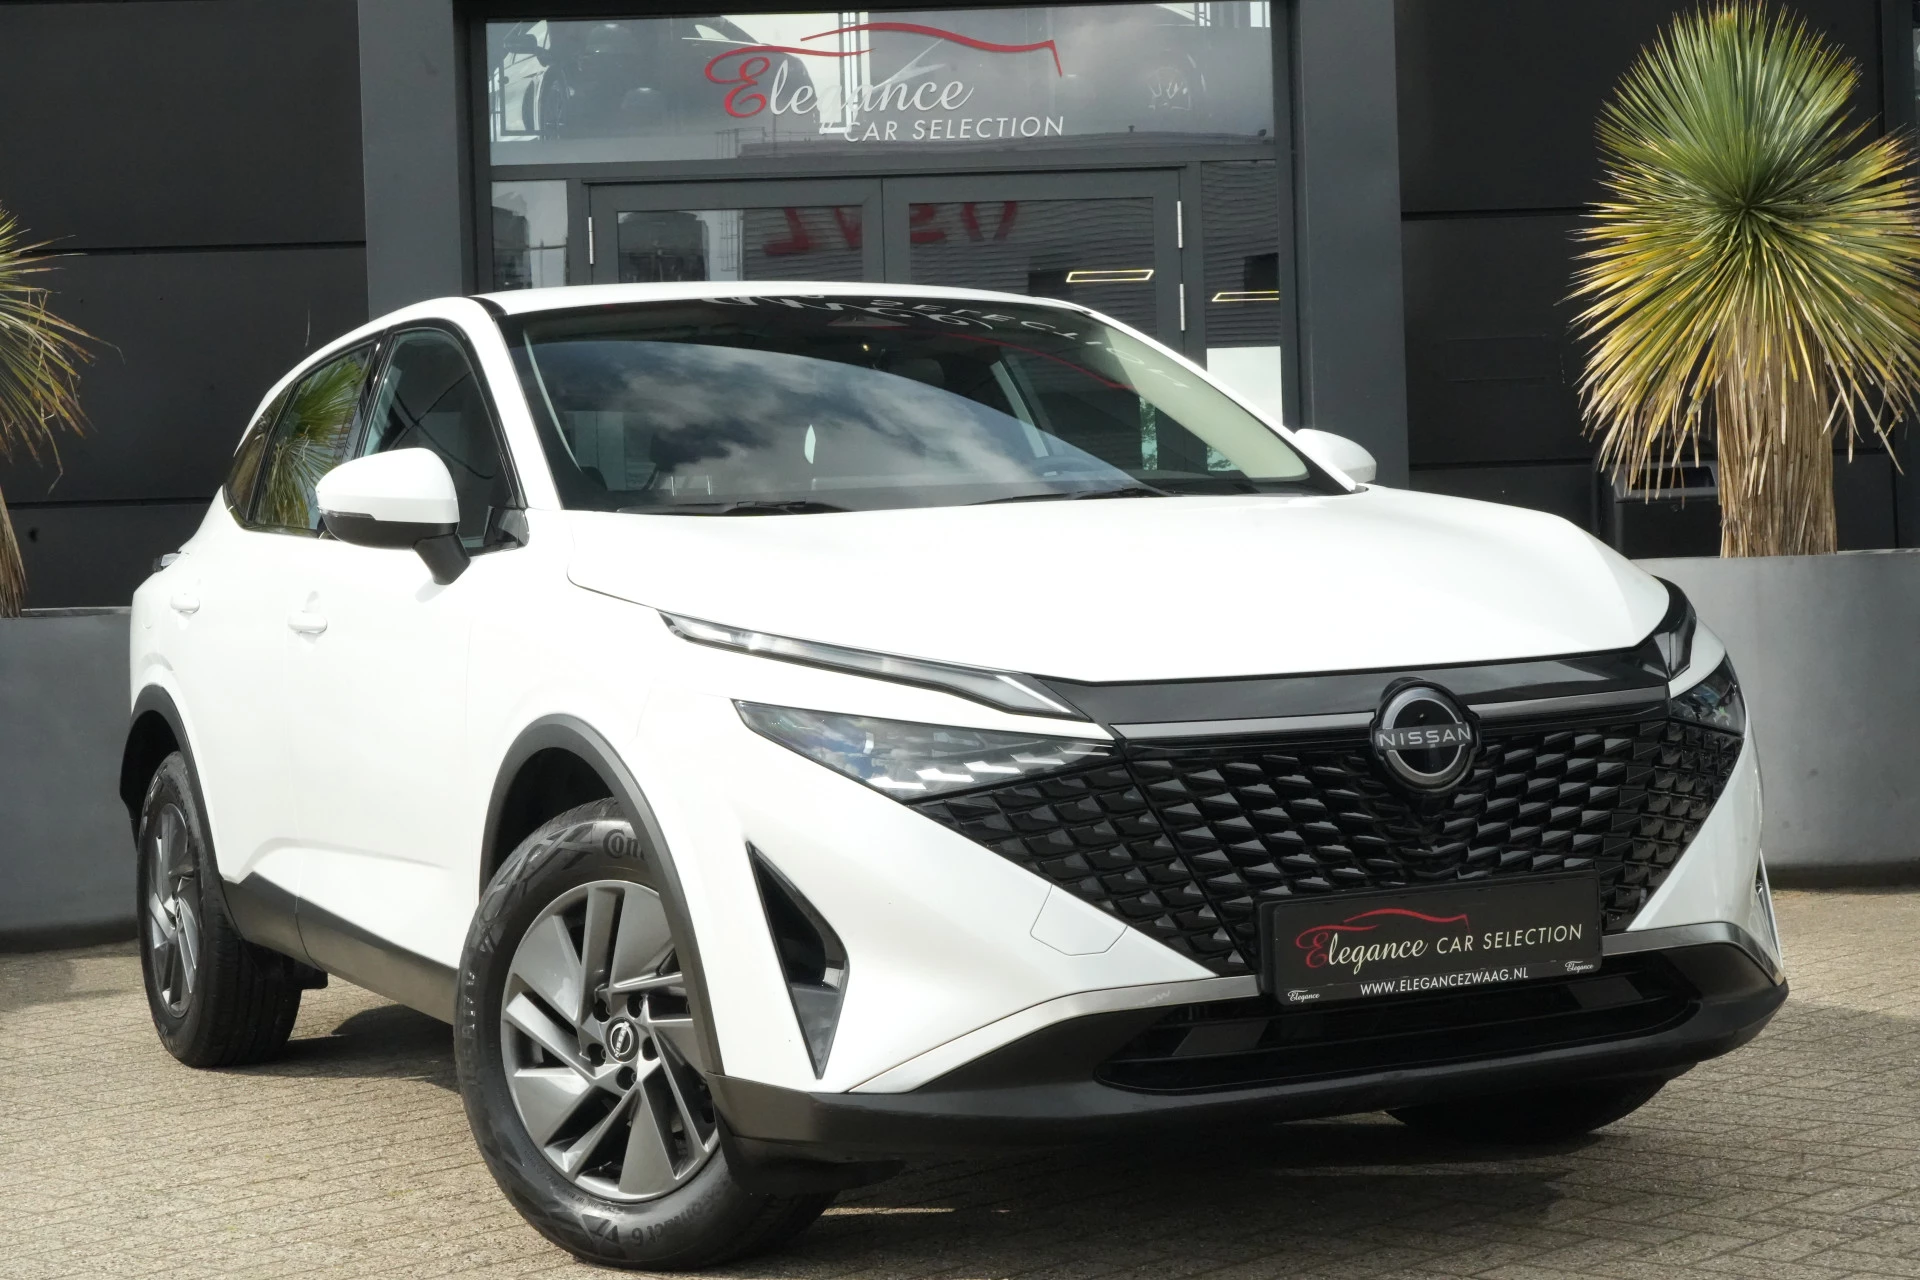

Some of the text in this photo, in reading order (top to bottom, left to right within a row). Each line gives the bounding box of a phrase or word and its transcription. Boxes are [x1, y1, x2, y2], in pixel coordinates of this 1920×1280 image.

[704, 46, 974, 134] Elegance
[844, 116, 1064, 142] CAR SELECTION
[1379, 727, 1471, 747] NISSAN
[1296, 924, 1583, 974] Elegance CAR SELECTION
[1360, 967, 1529, 996] WWW.ELEGANCEZWAAG.NL
